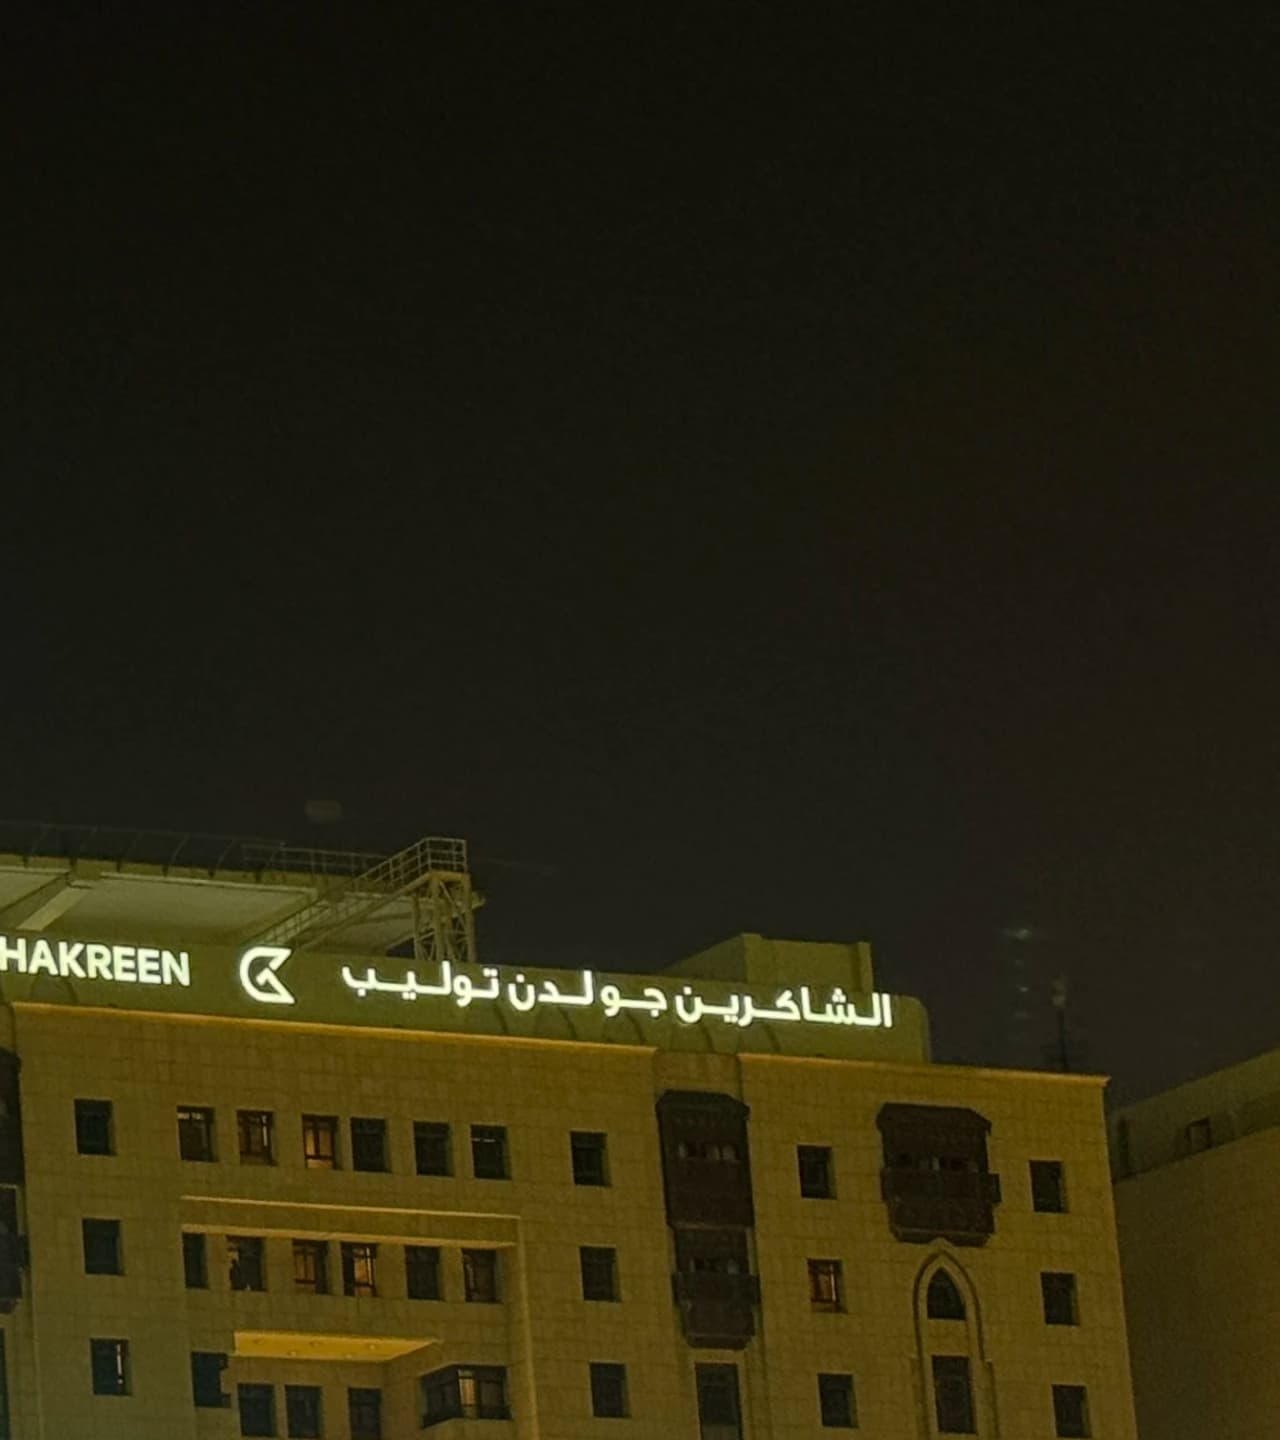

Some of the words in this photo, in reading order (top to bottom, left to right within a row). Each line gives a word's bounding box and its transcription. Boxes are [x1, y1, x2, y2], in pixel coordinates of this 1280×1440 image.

[341, 961, 501, 1008] توليب
[507, 969, 668, 1018] جولدن
[675, 986, 894, 1029] الشاكرين
